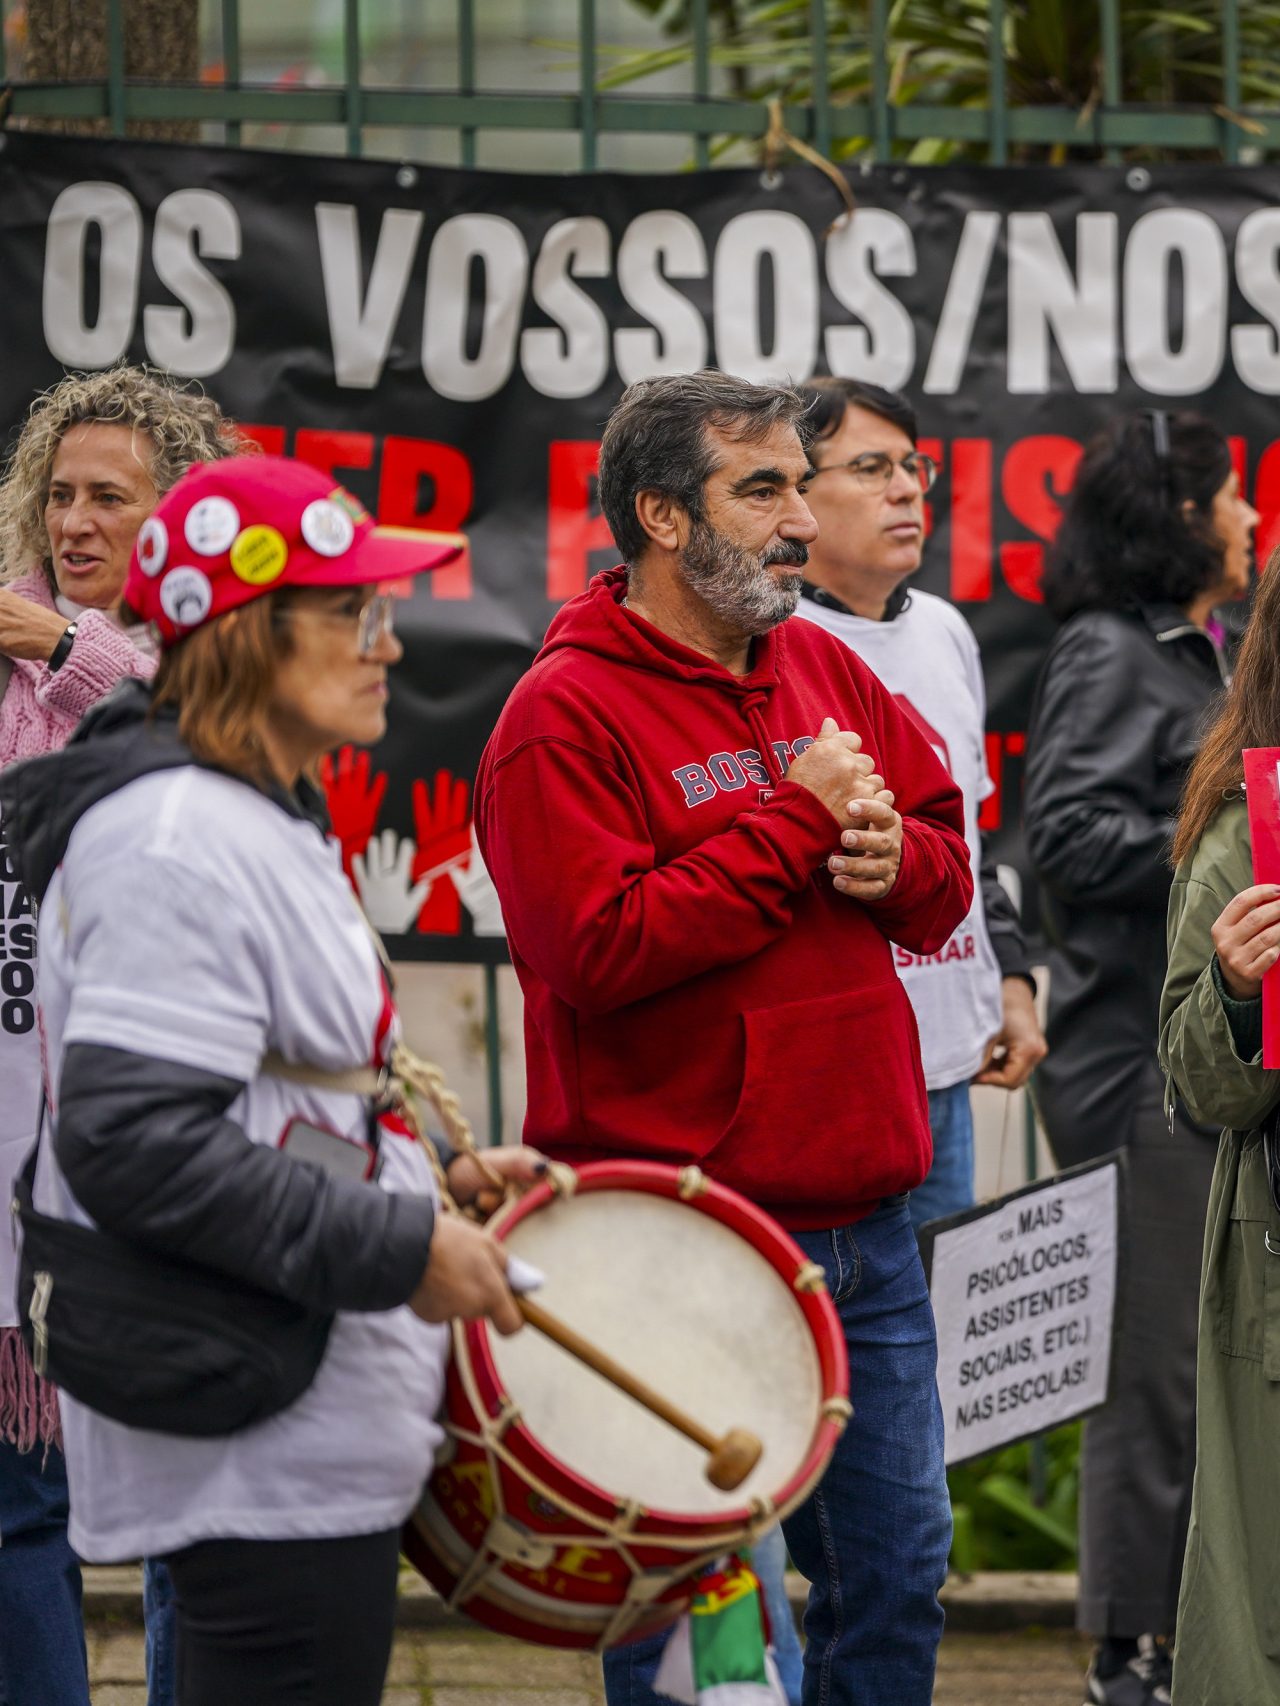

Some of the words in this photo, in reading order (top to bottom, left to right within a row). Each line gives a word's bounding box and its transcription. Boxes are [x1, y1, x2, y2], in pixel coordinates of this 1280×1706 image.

[42, 180, 241, 377] OS
[1017, 1199, 1064, 1236] MAIS
[966, 1233, 1091, 1299] PSICÓLOGOS,
[964, 1275, 1090, 1342] ASSISTENTES
[959, 1340, 1037, 1387] SOCIAIS,
[1043, 1316, 1091, 1355] ETC.)
[955, 1393, 993, 1431] NAS
[998, 1357, 1091, 1414] ESCOLAS!
